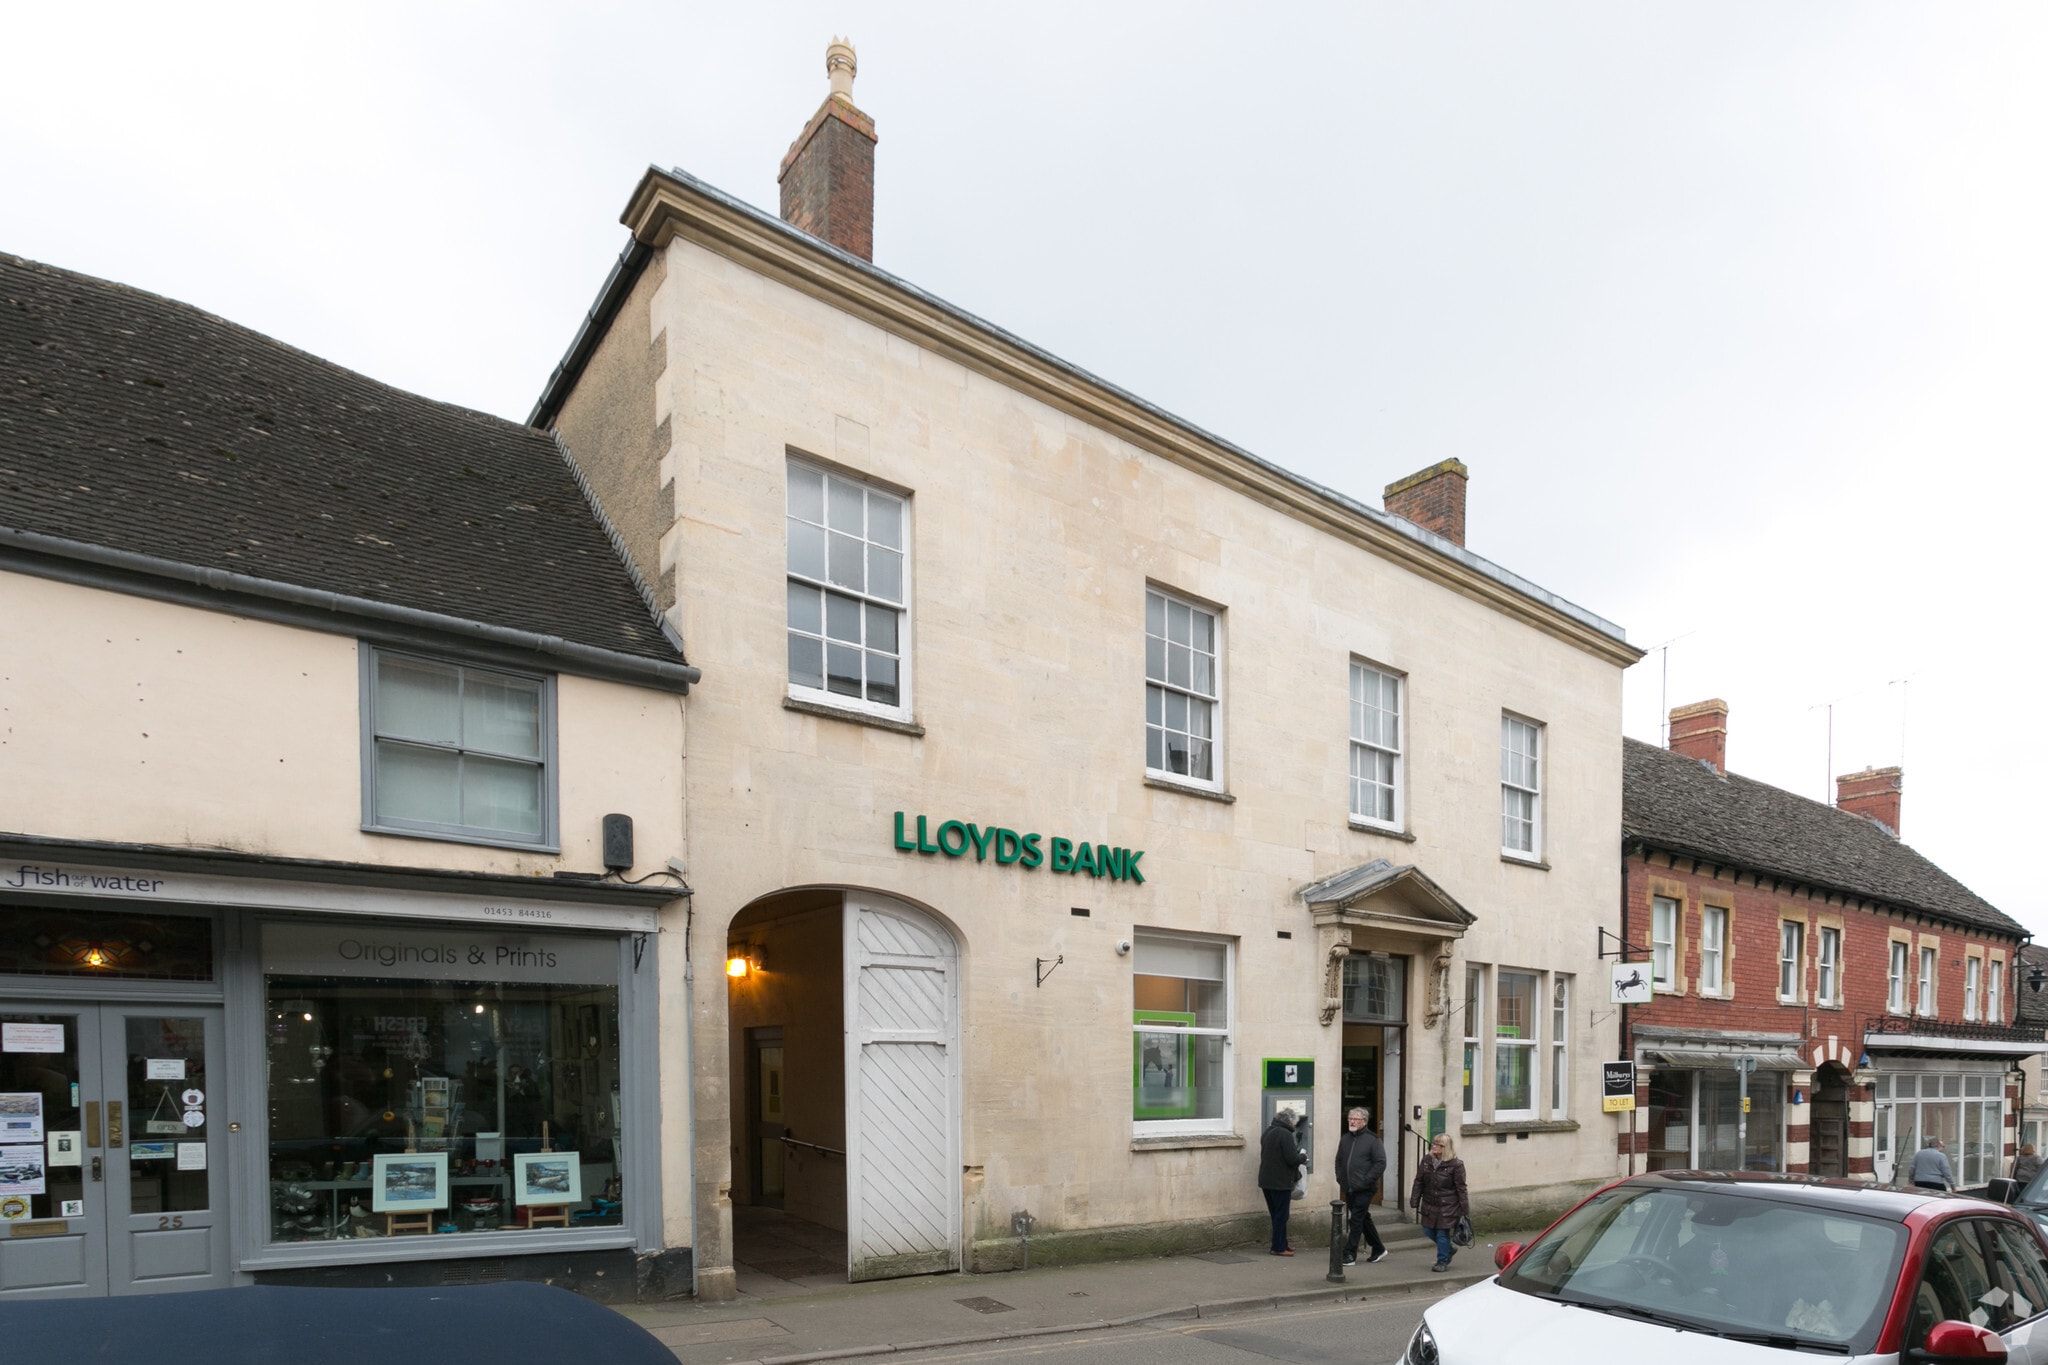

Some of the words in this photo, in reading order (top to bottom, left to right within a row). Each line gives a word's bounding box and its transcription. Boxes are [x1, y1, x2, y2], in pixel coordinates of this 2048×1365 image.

[894, 811, 1044, 867] LLOYDS
[1051, 837, 1145, 883] BANK
[6, 865, 69, 887] fish
[91, 875, 164, 892] water
[483, 906, 513, 917] 01453
[518, 909, 552, 919] 844316
[338, 939, 457, 967] Originals
[467, 945, 486, 965] &
[496, 946, 557, 968] Prints
[1609, 1098, 1617, 1106] TO
[1619, 1098, 1628, 1106] LET
[158, 1215, 183, 1230] 25
